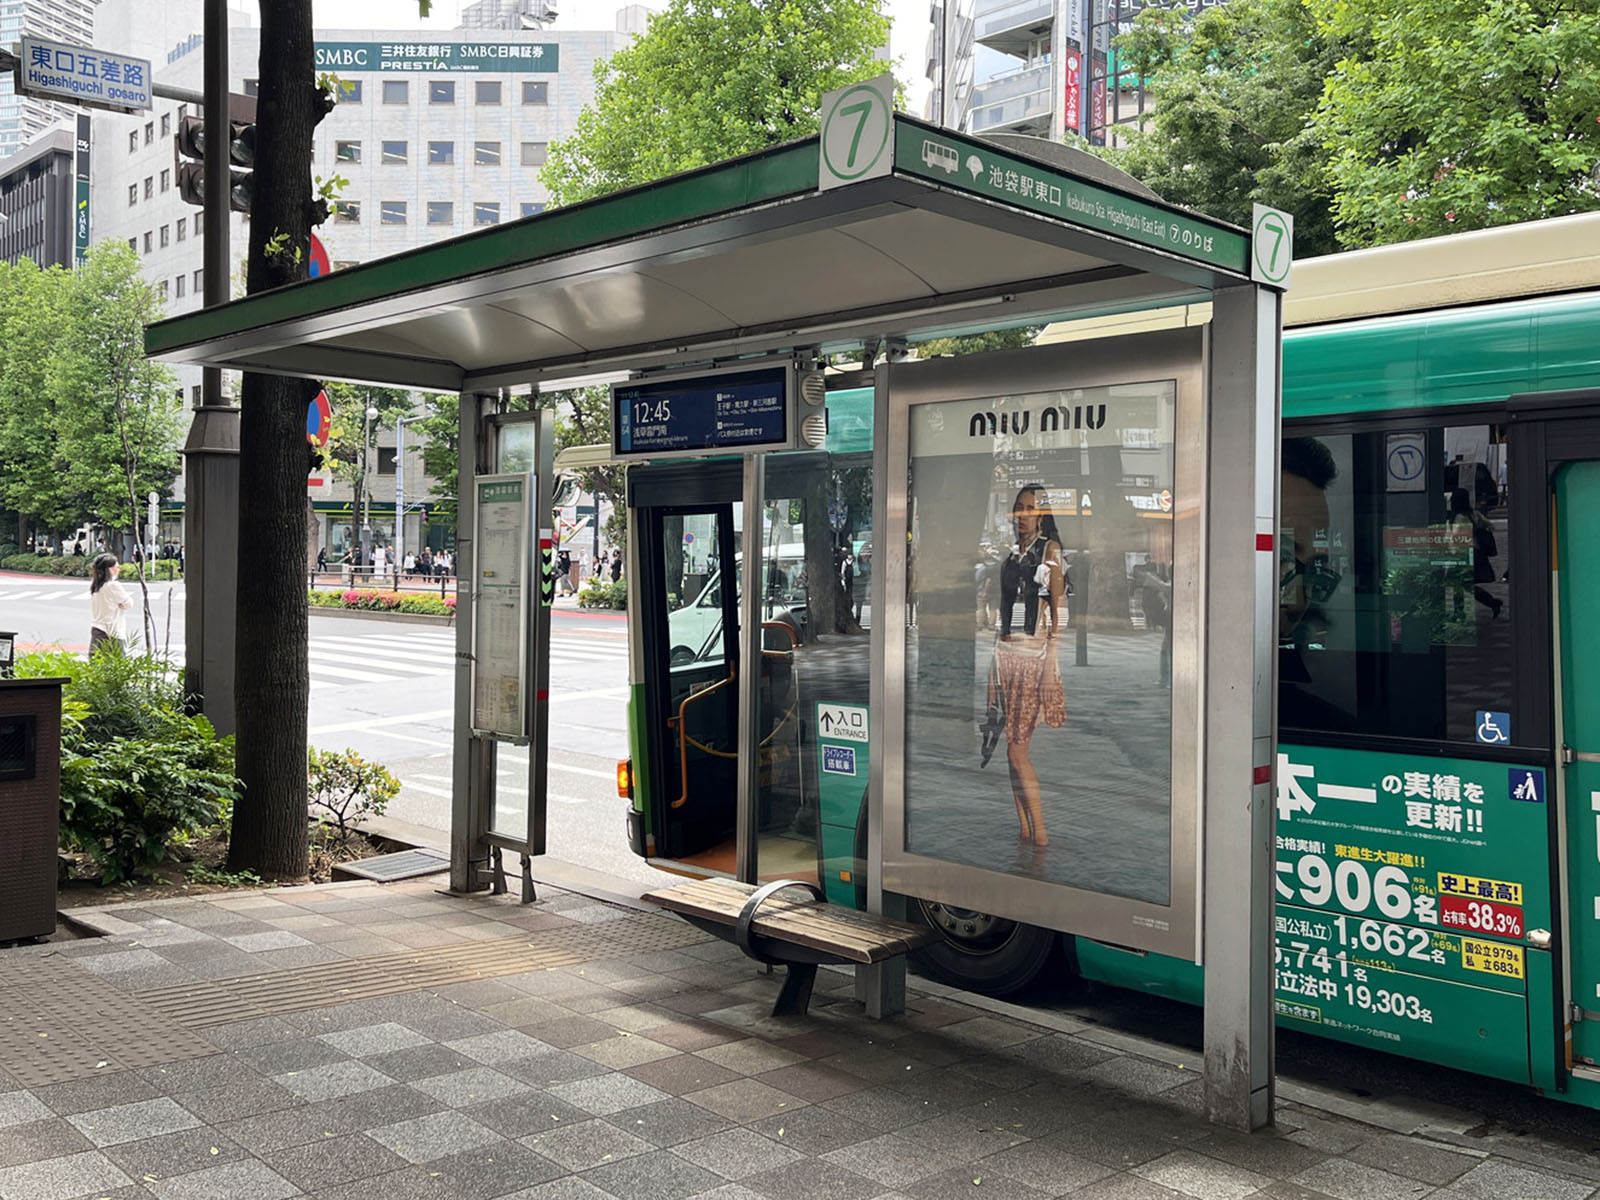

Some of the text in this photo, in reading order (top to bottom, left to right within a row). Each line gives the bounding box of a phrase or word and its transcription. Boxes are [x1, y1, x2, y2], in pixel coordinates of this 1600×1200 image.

[315, 49, 368, 66] SMBC
[381, 45, 544, 58] 三井住友銀行 SMBC日興証券
[31, 46, 143, 87] 東口五差路
[29, 69, 146, 102] Higashiguchi gosaro
[989, 164, 1062, 207] 池袋駅東口
[1066, 192, 1095, 216] Ikebukuro
[1107, 205, 1140, 231] Higashiguchi
[634, 400, 671, 424] 12:45
[837, 711, 862, 728] 入口
[834, 727, 867, 740] ENTRANCE
[1381, 771, 1485, 804] の実績を
[1405, 800, 1484, 833] 更新!!
[1334, 843, 1425, 869] 東進生大躍進!!
[1441, 875, 1519, 902] 史上最高!
[1344, 983, 1433, 1024] 19,303名
